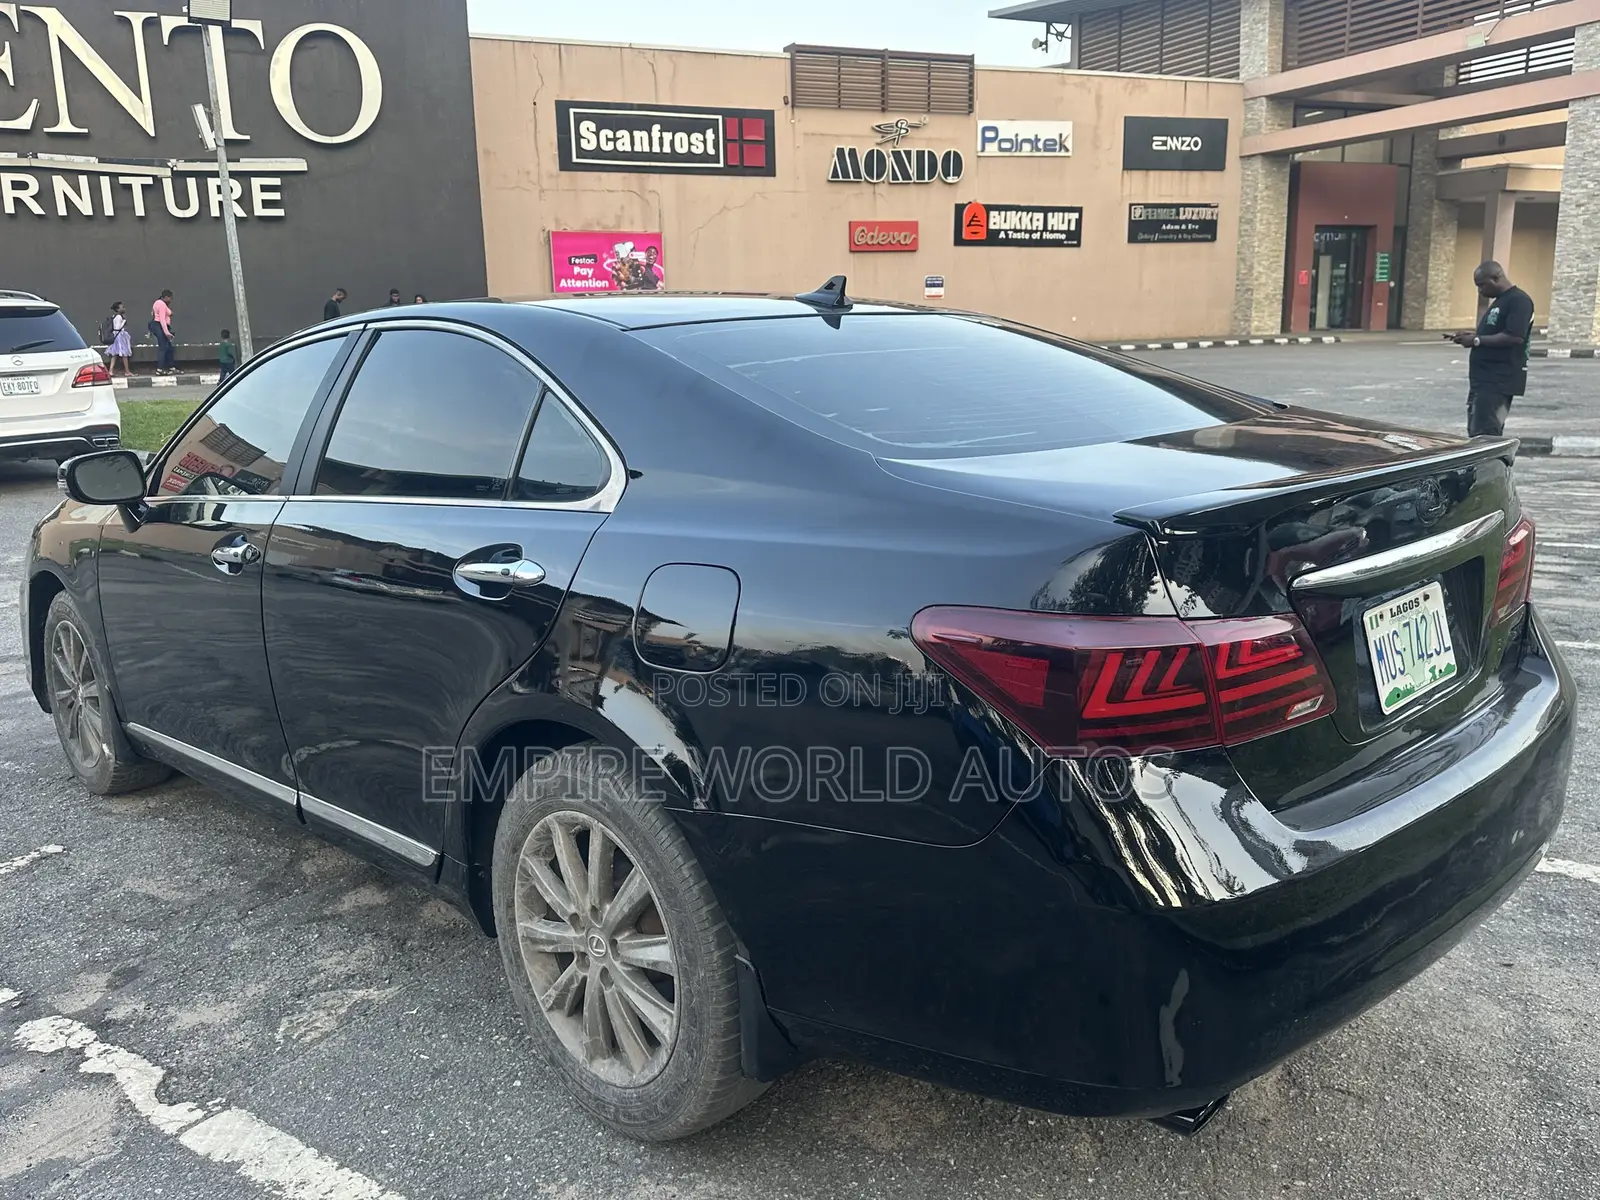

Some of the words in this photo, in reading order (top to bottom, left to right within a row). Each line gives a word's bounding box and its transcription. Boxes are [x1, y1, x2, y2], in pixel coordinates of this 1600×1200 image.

[579, 120, 716, 155] Scanfrost
[980, 125, 1071, 153] Pointek
[828, 146, 965, 185] MONDO
[988, 210, 1044, 231] BUKKA
[1048, 211, 1080, 231] HUT
[998, 231, 1007, 239] A
[1007, 231, 1030, 239] Taste
[1031, 231, 1041, 240] of
[1042, 231, 1067, 240] Home
[571, 257, 595, 265] Festac
[560, 278, 609, 288] Attention
[573, 267, 594, 278] Pay
[1390, 597, 1421, 619] LAGOS
